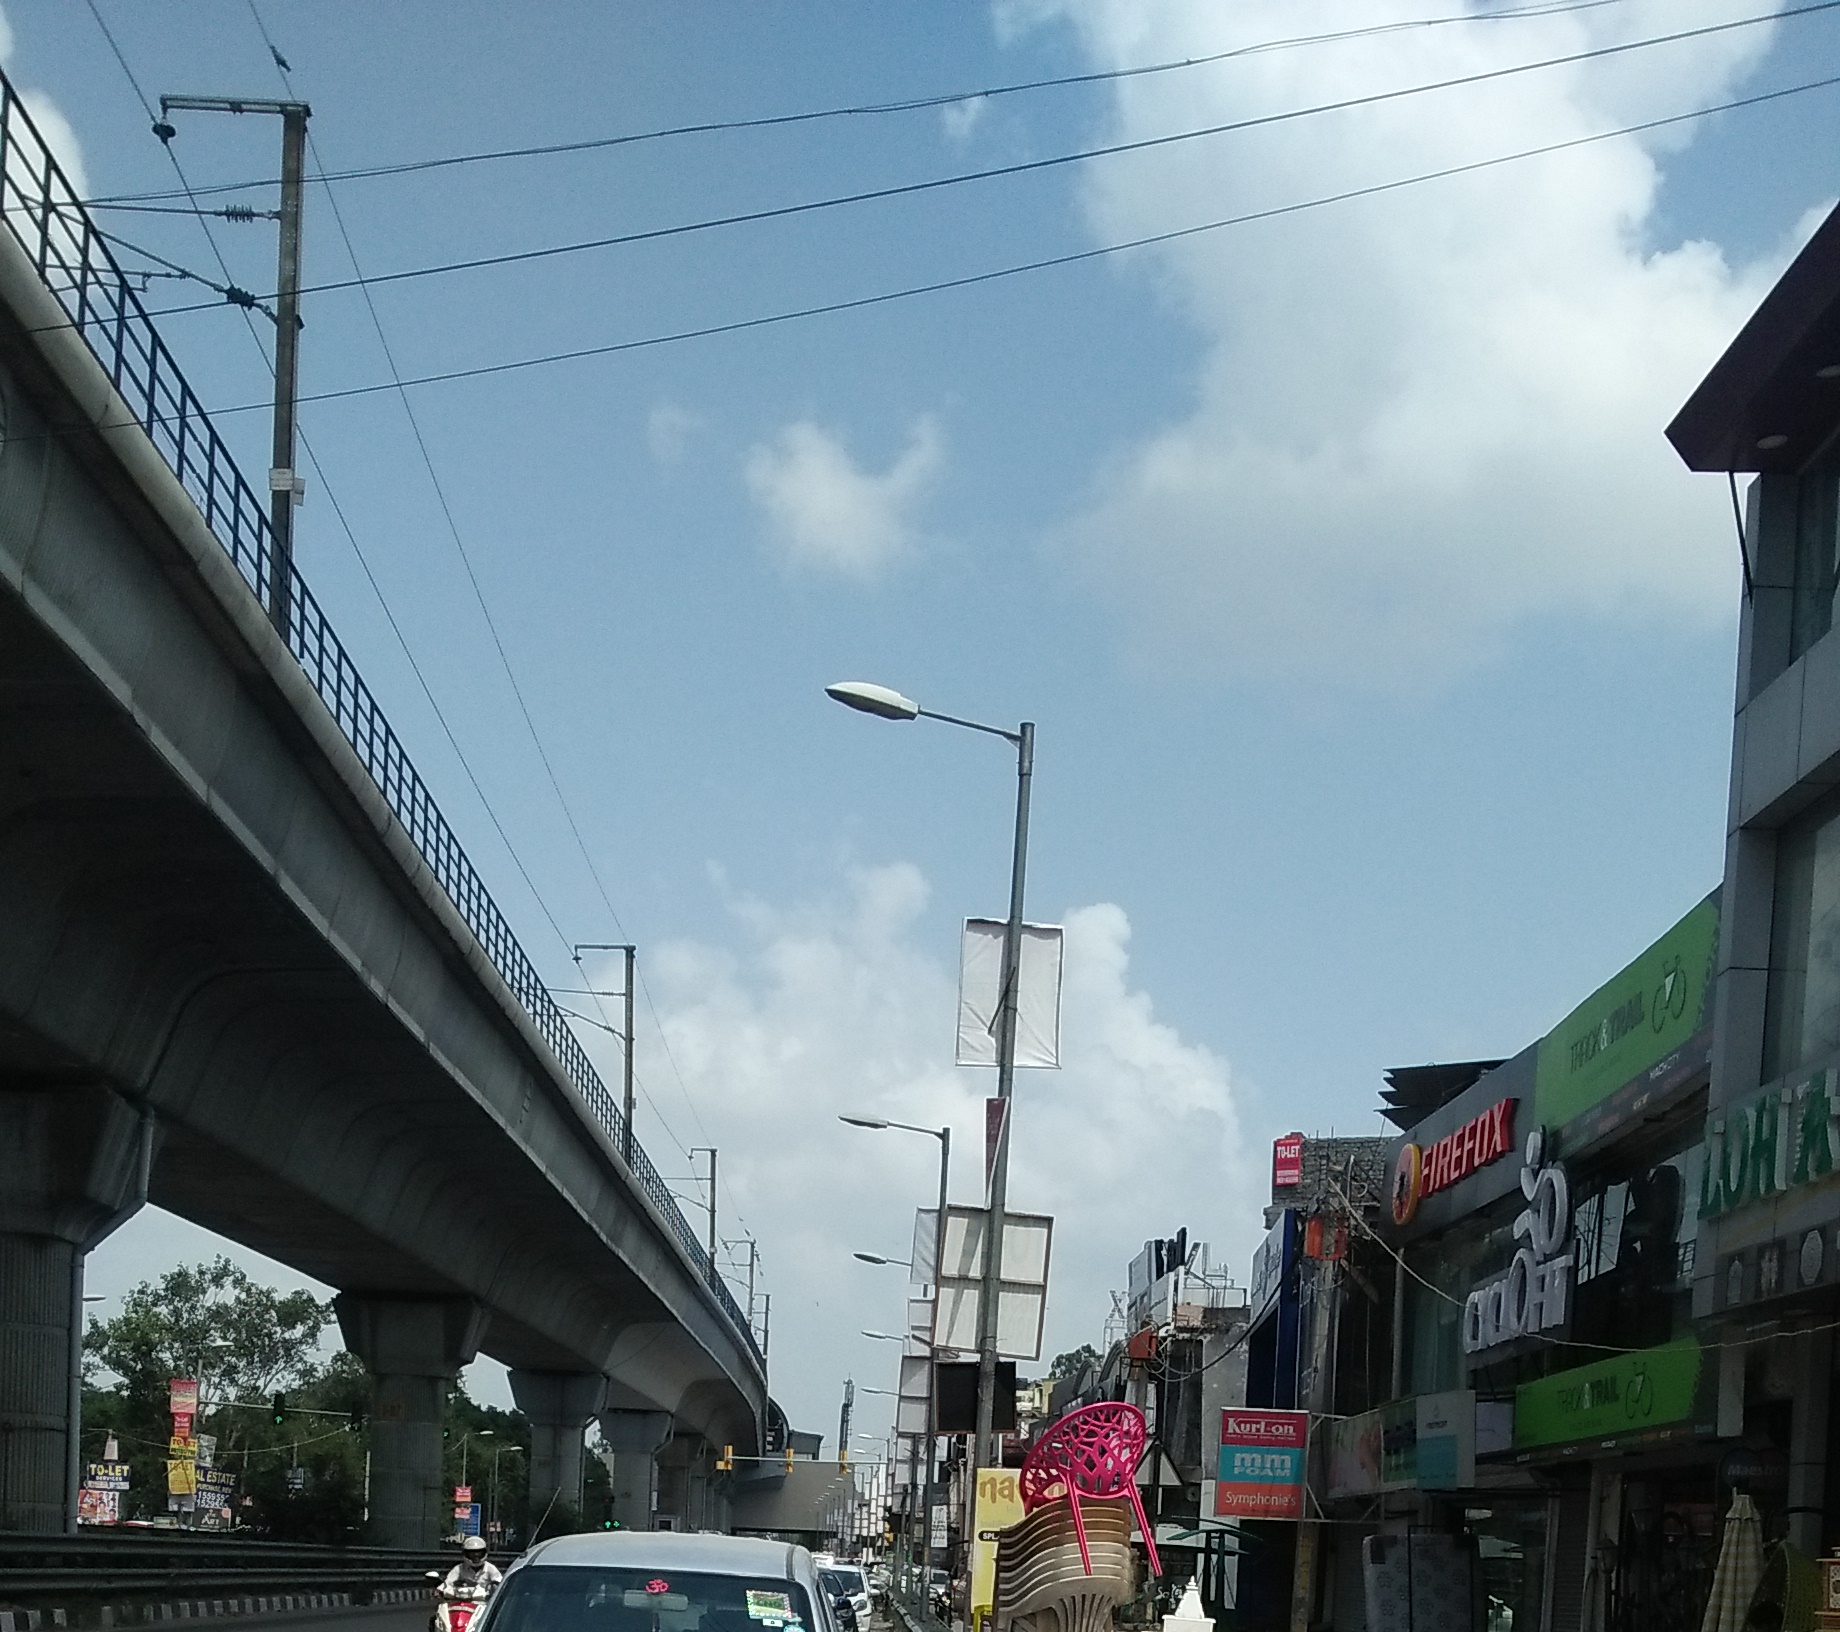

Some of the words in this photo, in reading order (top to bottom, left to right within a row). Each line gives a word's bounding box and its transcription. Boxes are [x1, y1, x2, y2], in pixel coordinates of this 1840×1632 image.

[1418, 1097, 1511, 1199] FIREFOX
[1227, 1417, 1295, 1435] Kurl-on
[1234, 1453, 1291, 1468] mm
[206, 1470, 237, 1486] ESTATE
[1233, 1467, 1291, 1477] FOAM
[1225, 1491, 1297, 1507] Symphonie's
